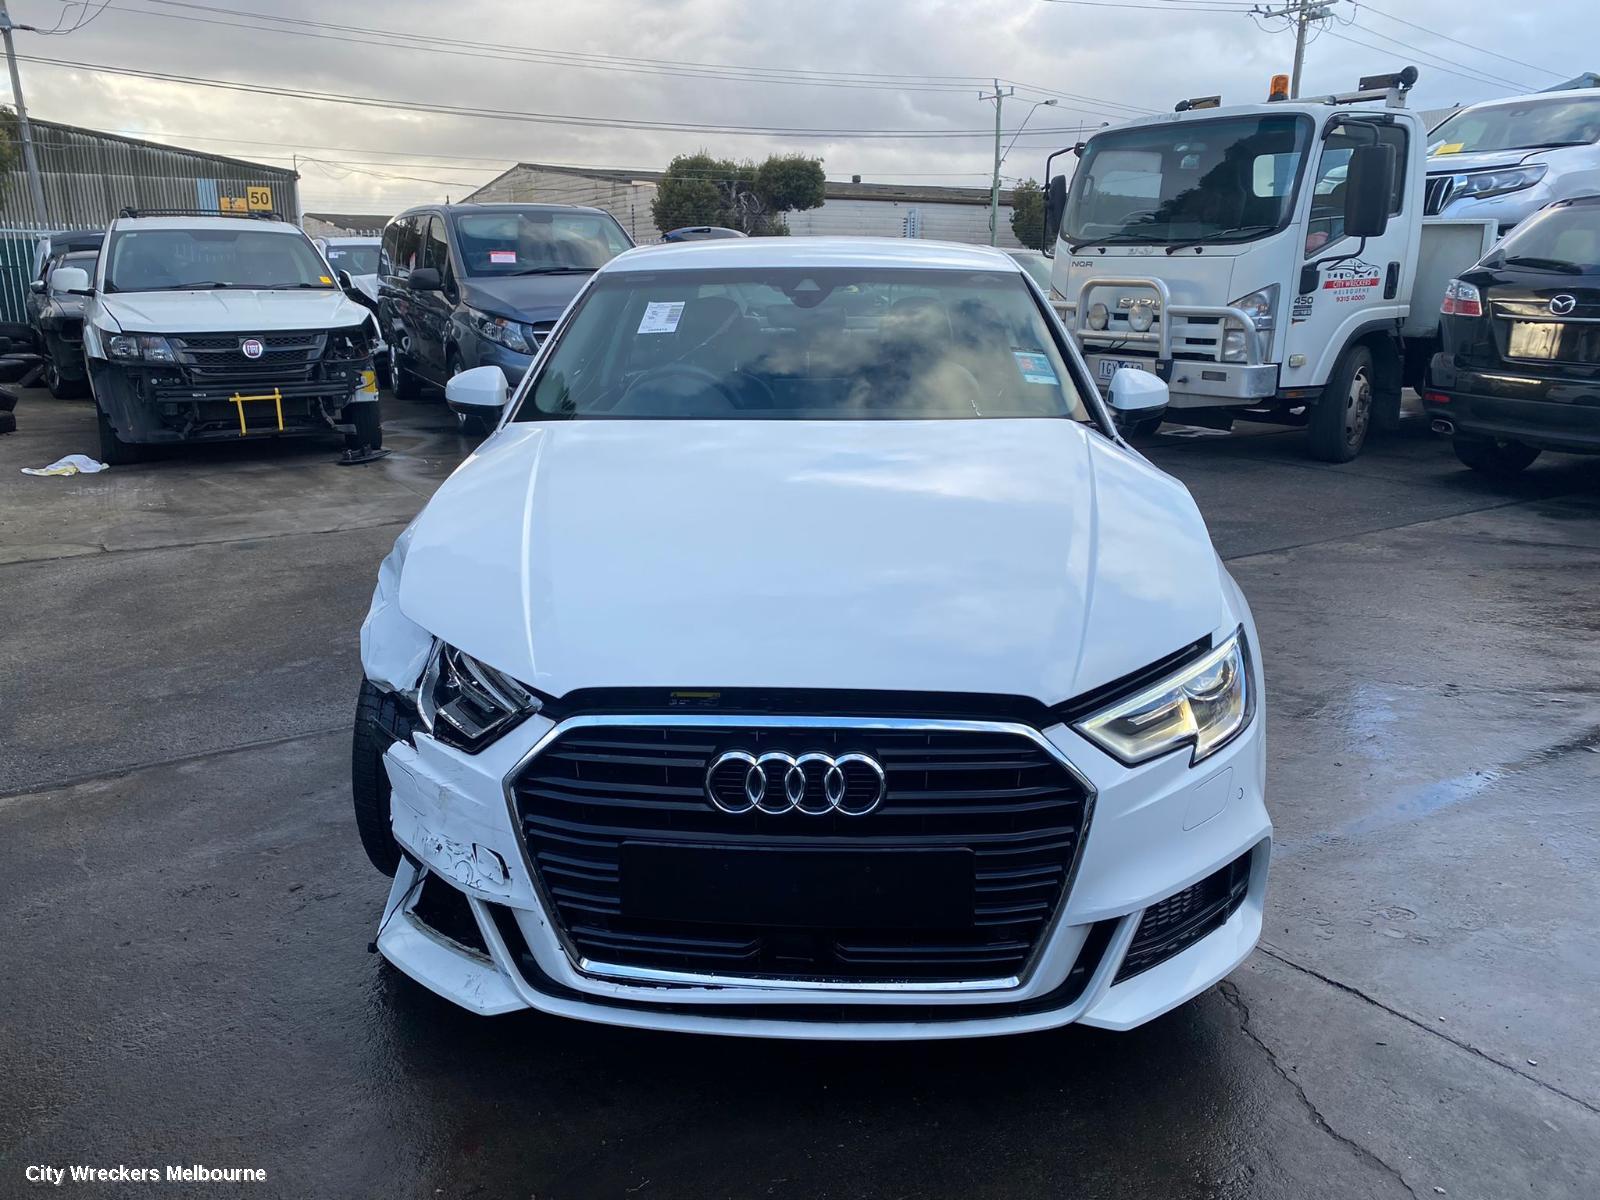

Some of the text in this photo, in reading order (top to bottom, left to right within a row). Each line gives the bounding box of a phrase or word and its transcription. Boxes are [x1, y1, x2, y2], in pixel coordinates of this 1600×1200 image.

[250, 191, 269, 205] 50
[1071, 260, 1094, 268] NQR
[1332, 280, 1344, 288] CITY
[1294, 296, 1314, 305] 450
